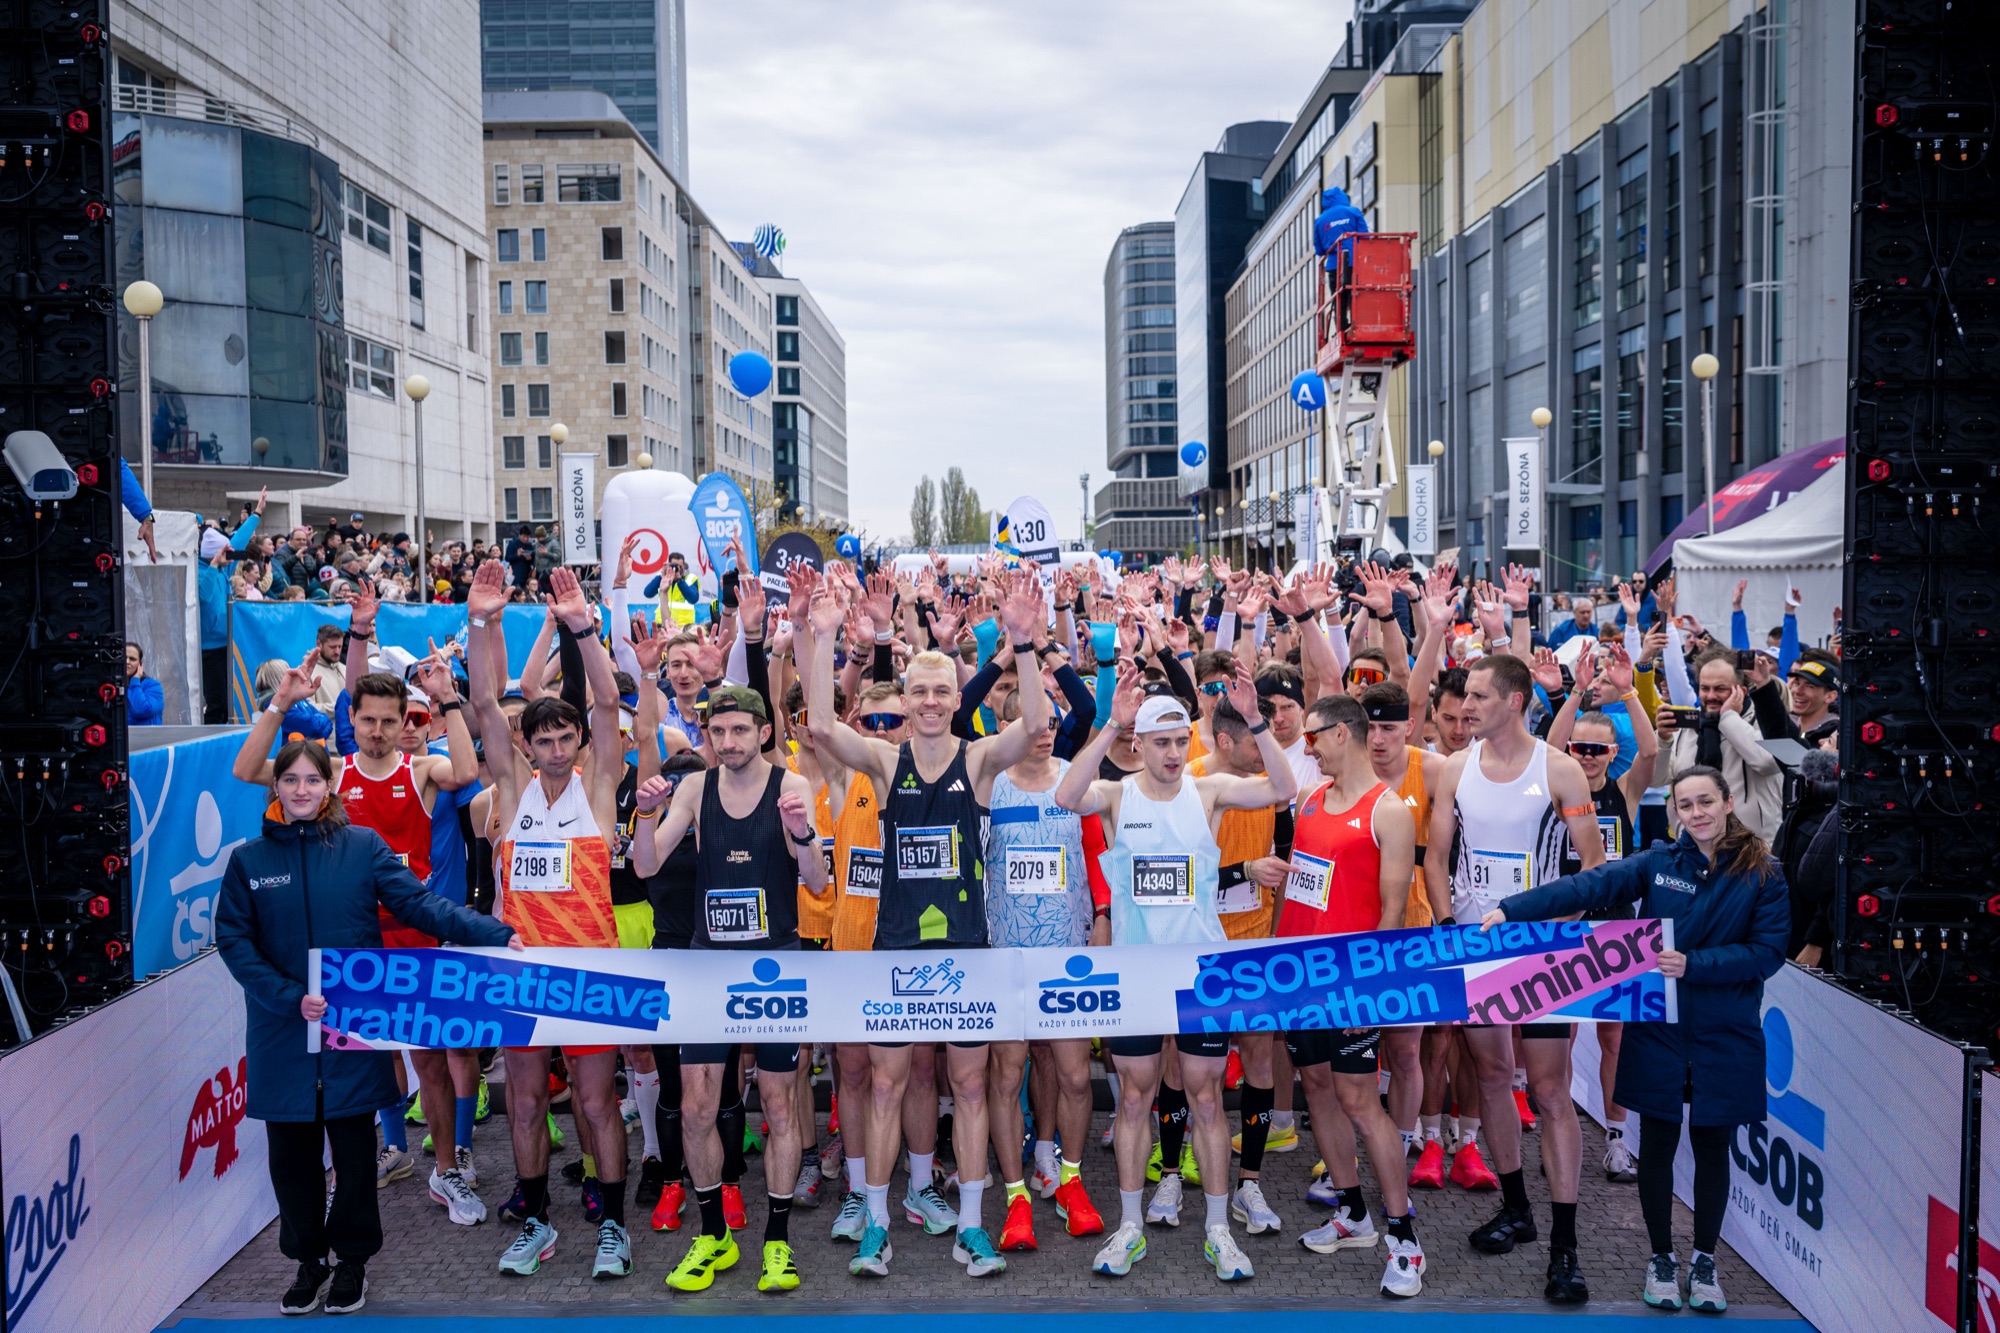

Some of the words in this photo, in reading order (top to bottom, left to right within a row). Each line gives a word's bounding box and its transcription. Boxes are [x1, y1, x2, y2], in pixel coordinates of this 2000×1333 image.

[1517, 453, 1530, 503] SEZÓNA
[571, 468, 585, 519] SEZÓNA
[1413, 477, 1427, 543] ČINOHRA
[1519, 508, 1530, 535] 106.
[575, 523, 586, 551] 106.
[1013, 519, 1046, 543] 1:30
[1300, 513, 1309, 542] BALET
[514, 856, 547, 877] 2198
[901, 846, 937, 863] 15157
[1010, 861, 1044, 880] 2079
[1136, 873, 1174, 890] 14349
[1474, 865, 1489, 884] 31
[710, 908, 745, 926] 15071
[1193, 952, 1339, 1007] ČSOB
[1351, 921, 1593, 976] Bratislava
[430, 958, 671, 1021] Bratislava
[1038, 989, 1121, 1014] ČSOB
[726, 994, 808, 1020] ČSOB
[862, 999, 903, 1016] ČSOB
[907, 1001, 997, 1014] BRATISLAVA
[1201, 982, 1440, 1031] Marathon
[724, 1025, 753, 1034] KAŽDÝ
[756, 1025, 774, 1033] DEŇ
[778, 1025, 808, 1033] SMART
[865, 1018, 954, 1031] MARATHON
[958, 1017, 994, 1030] 2026
[1039, 1018, 1066, 1028] KAŽDÝ
[1070, 1018, 1088, 1027] DEŇ
[1092, 1018, 1121, 1026] SMART
[1729, 1186, 1756, 1219] AŽDÝ
[1760, 1209, 1780, 1242] DEŇ
[1785, 1231, 1822, 1279] SMART
